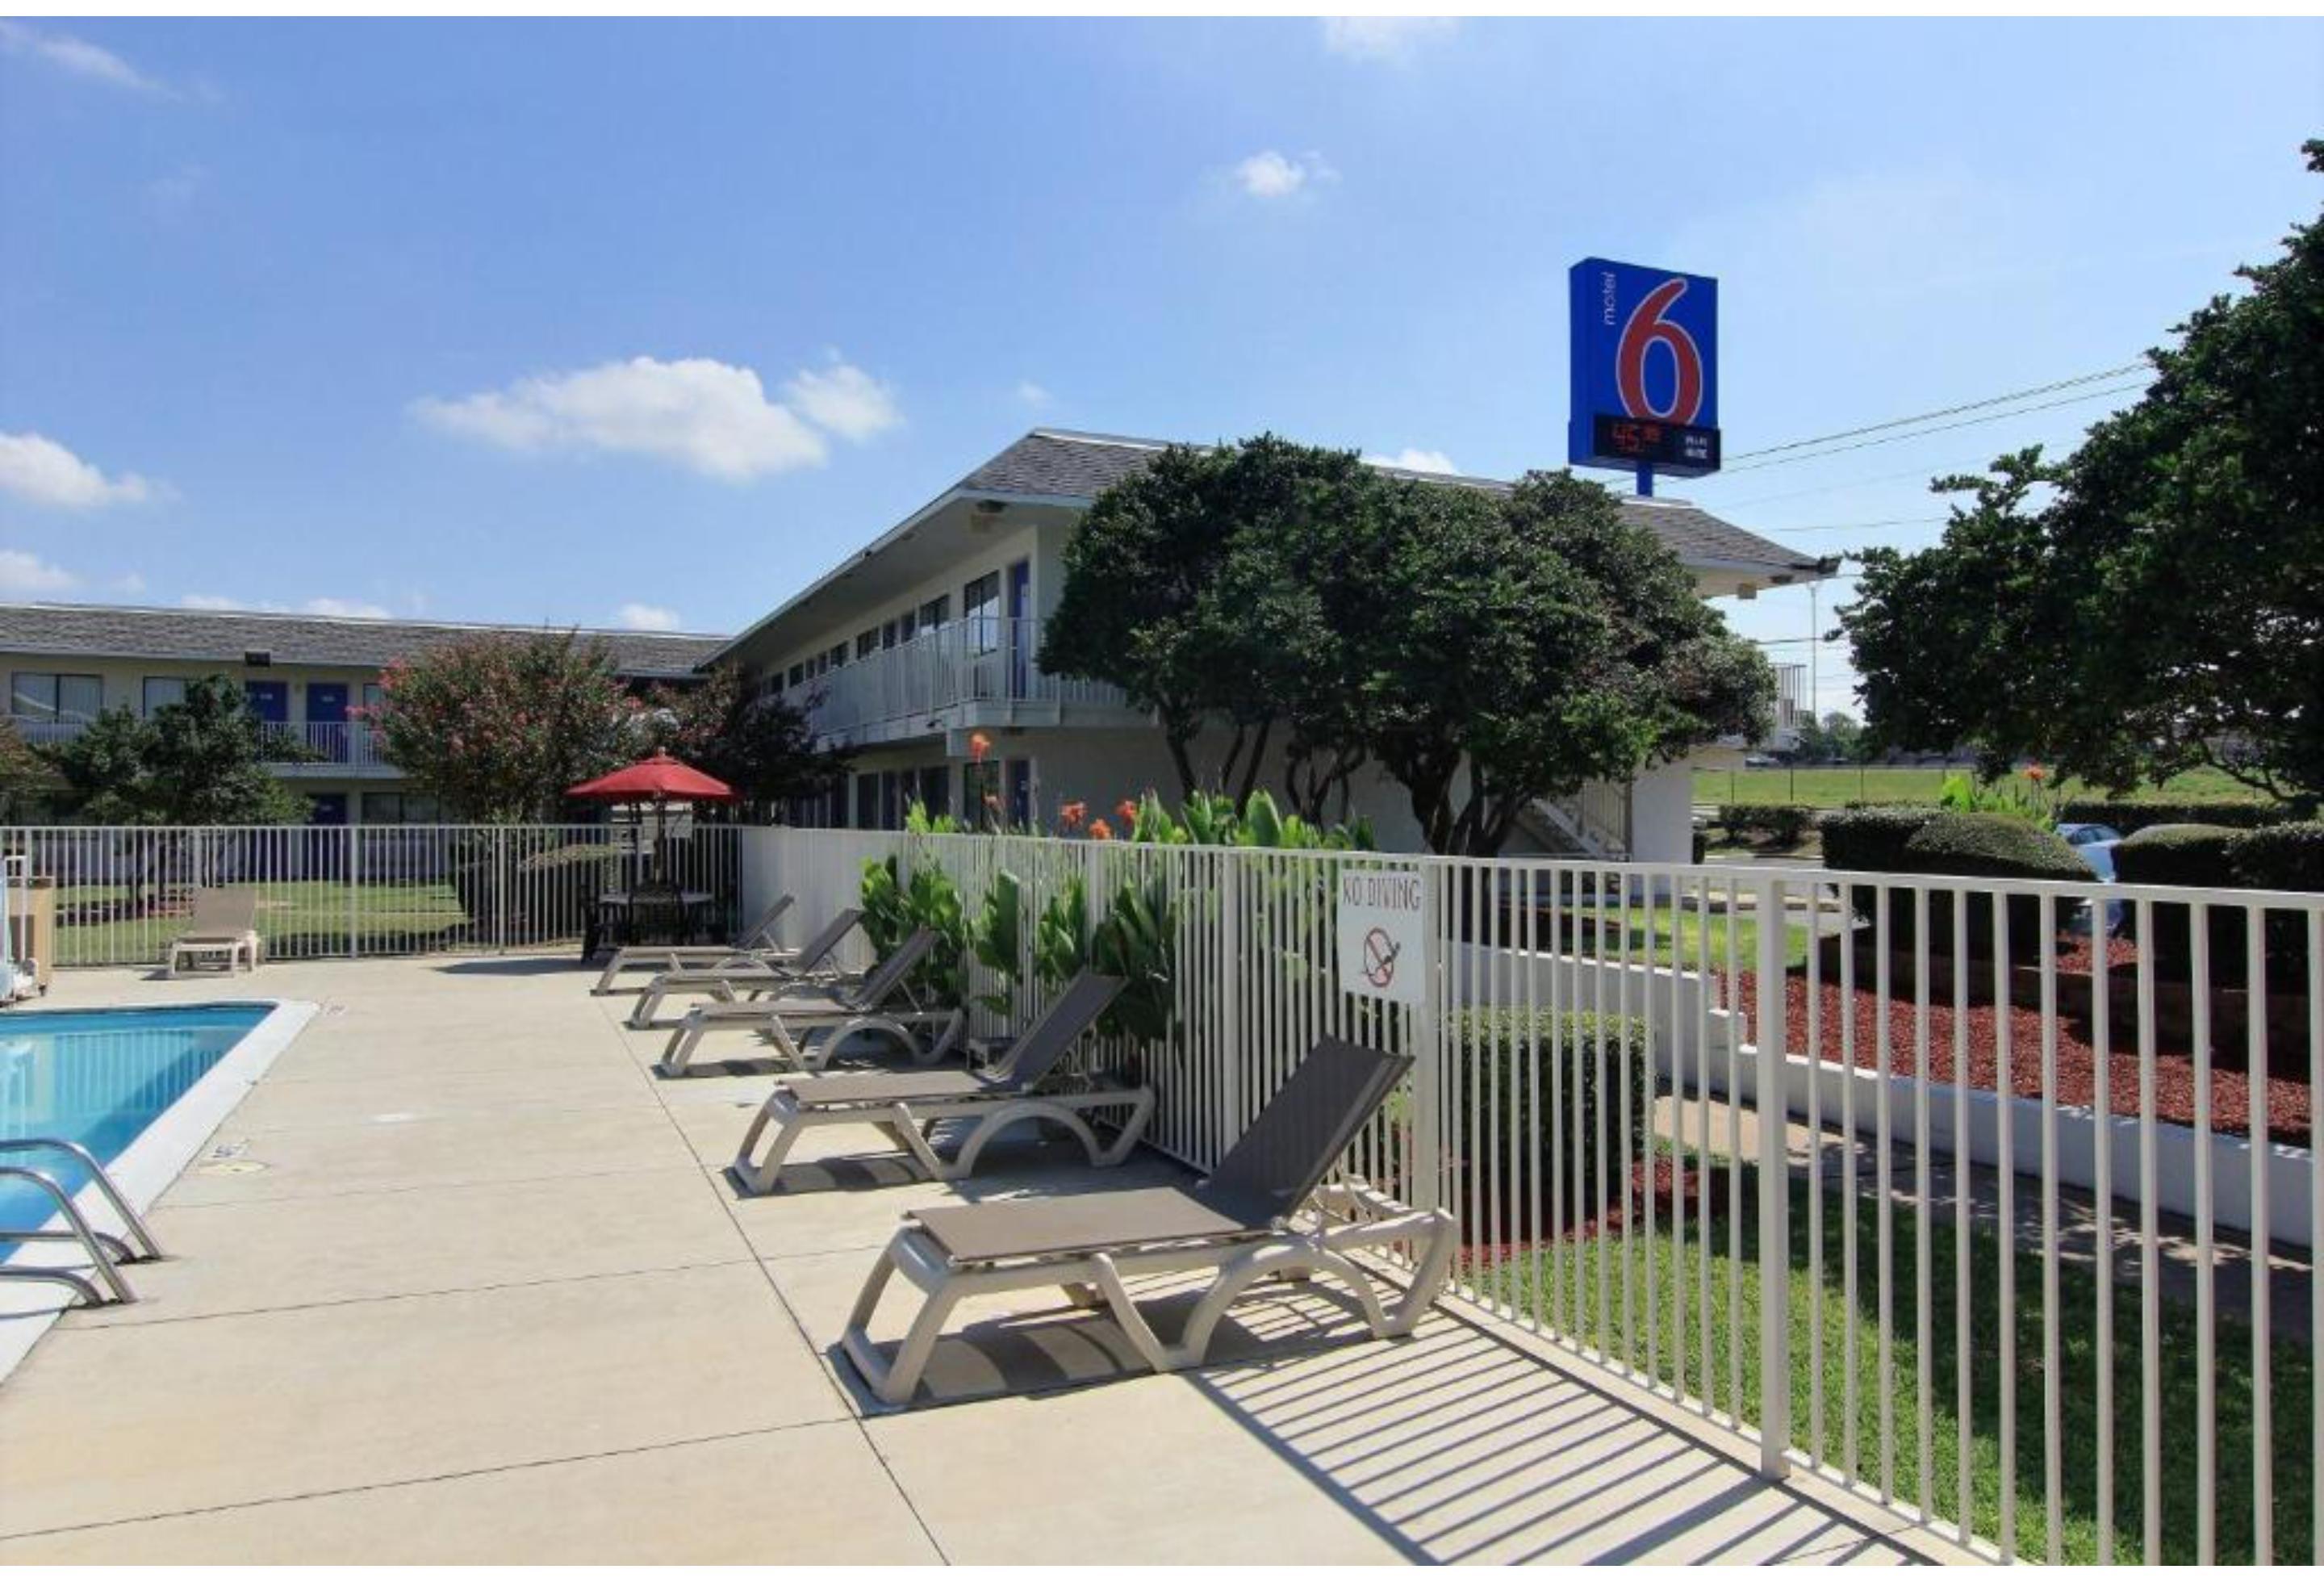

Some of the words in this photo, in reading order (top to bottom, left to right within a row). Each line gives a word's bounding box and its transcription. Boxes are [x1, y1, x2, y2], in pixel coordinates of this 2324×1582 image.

[1601, 271, 1616, 325] motel
[1616, 277, 1703, 425] 6
[1343, 876, 1362, 906] NO
[1368, 877, 1421, 911] DIVING
